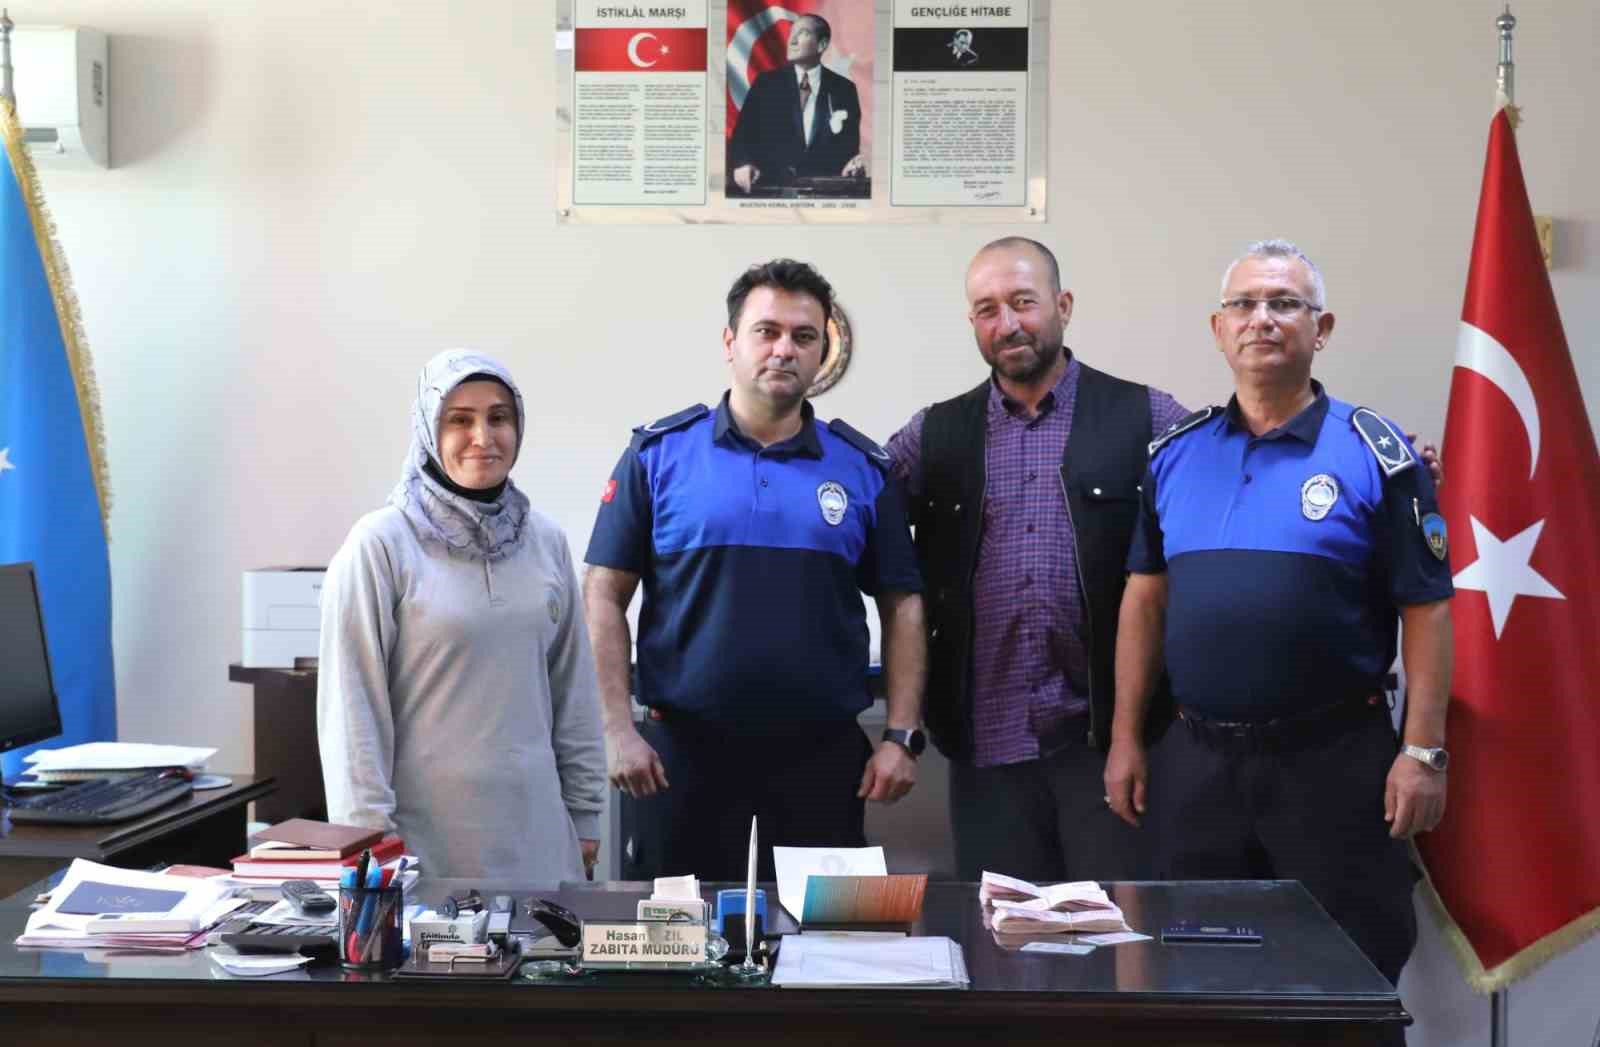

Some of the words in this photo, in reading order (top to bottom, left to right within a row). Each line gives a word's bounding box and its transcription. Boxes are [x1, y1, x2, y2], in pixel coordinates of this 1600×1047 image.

[649, 8, 686, 19] MARŞI
[606, 930, 646, 941] Hasan
[590, 944, 638, 955] ZABITA
